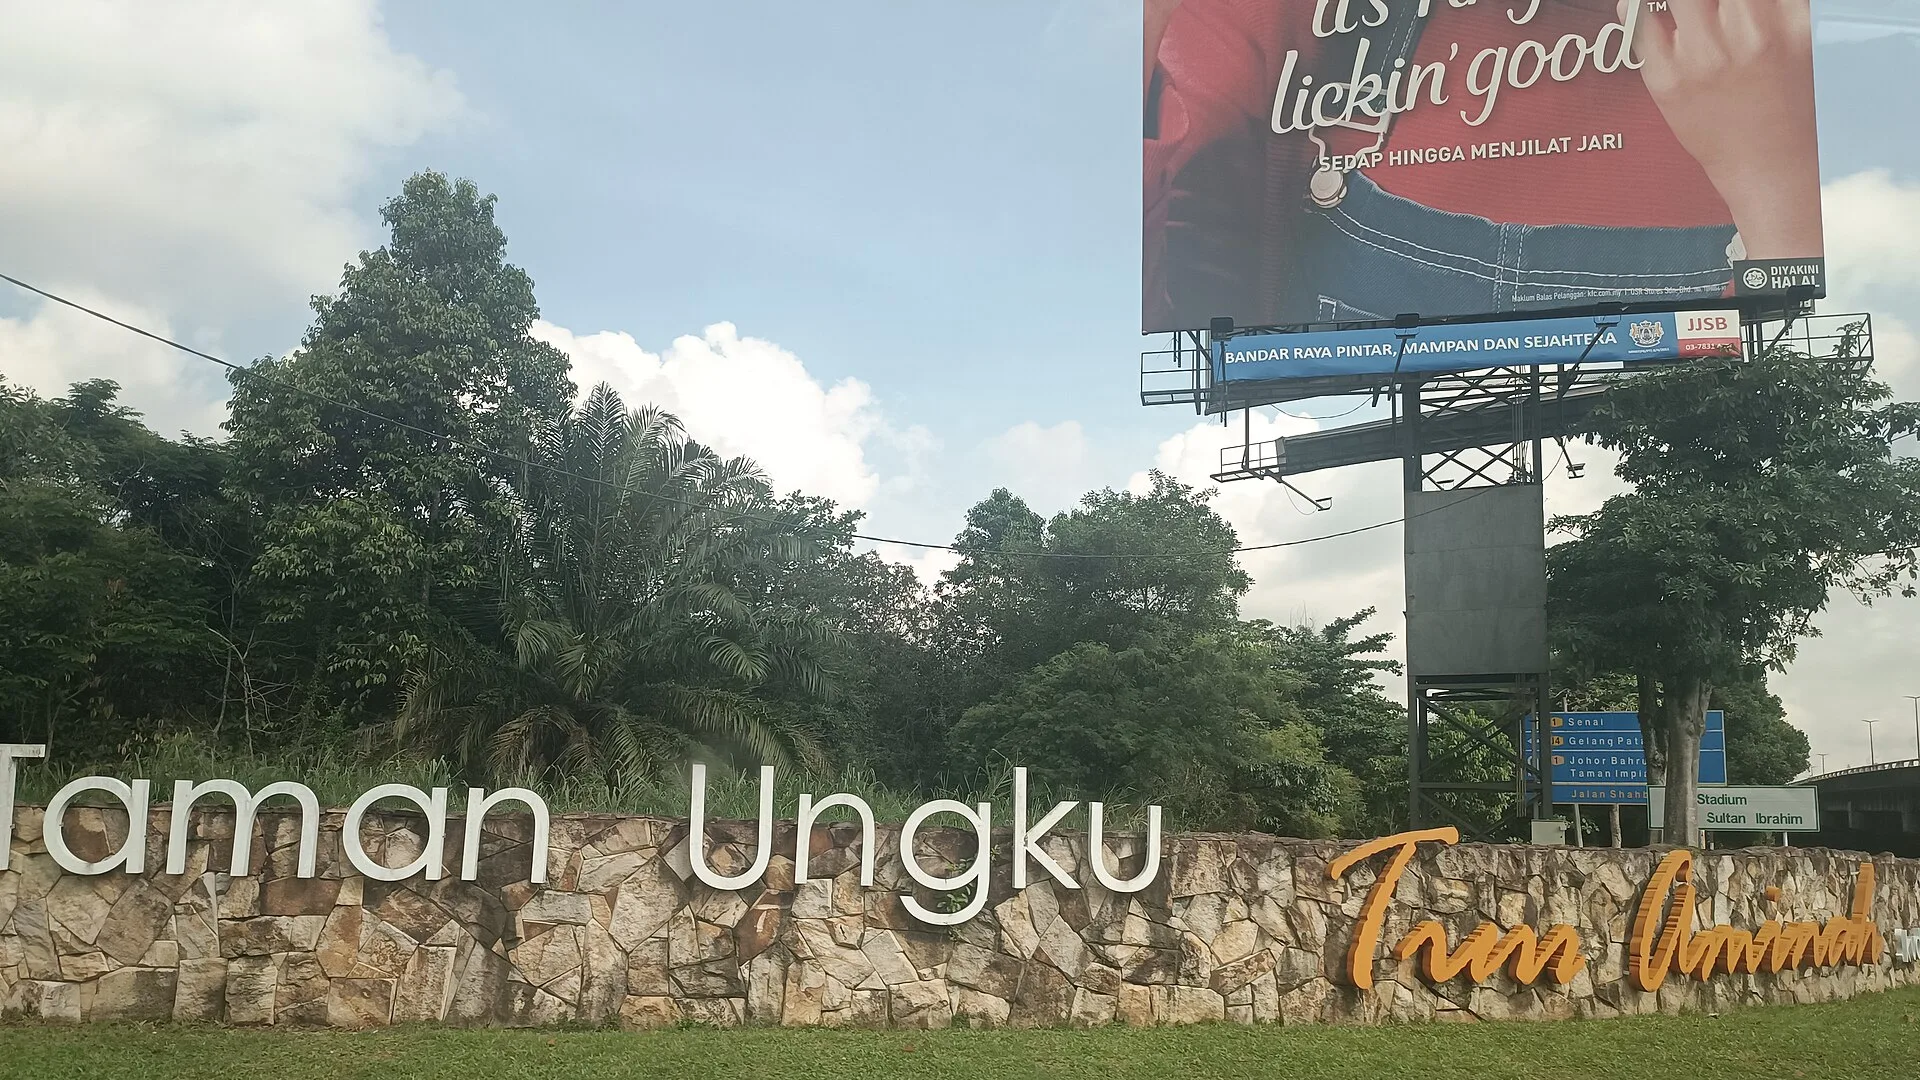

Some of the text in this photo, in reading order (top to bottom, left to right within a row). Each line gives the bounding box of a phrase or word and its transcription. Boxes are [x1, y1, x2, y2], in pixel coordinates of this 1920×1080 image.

[1271, 0, 1646, 134] lickin' good
[1319, 133, 1623, 172] SEDAP HINGGA MENJILAT JARI
[1770, 264, 1819, 276] DIYAKINI
[1511, 294, 1535, 302] Maklum
[1536, 293, 1553, 301] Balas
[1587, 289, 1621, 298] kfc.com.my
[1687, 317, 1728, 331] JJSB
[1225, 345, 1290, 364] BANDAR
[1293, 345, 1333, 360] RAYA
[1336, 343, 1398, 359] PINTAR,
[1403, 338, 1479, 355] MAMPAN
[1483, 334, 1521, 351] DAN
[1568, 717, 1604, 726] Senai
[1568, 736, 1613, 747] Gelang
[1569, 756, 1606, 765] Johor
[1611, 756, 1647, 765] Bahru
[1570, 768, 1611, 778] Taman
[1571, 789, 1647, 798] Jalan Shahb
[1696, 793, 1748, 806] Stadium
[1706, 811, 1803, 825] Sultan Ibrahim
[0, 744, 1163, 926] Taman Ungku
